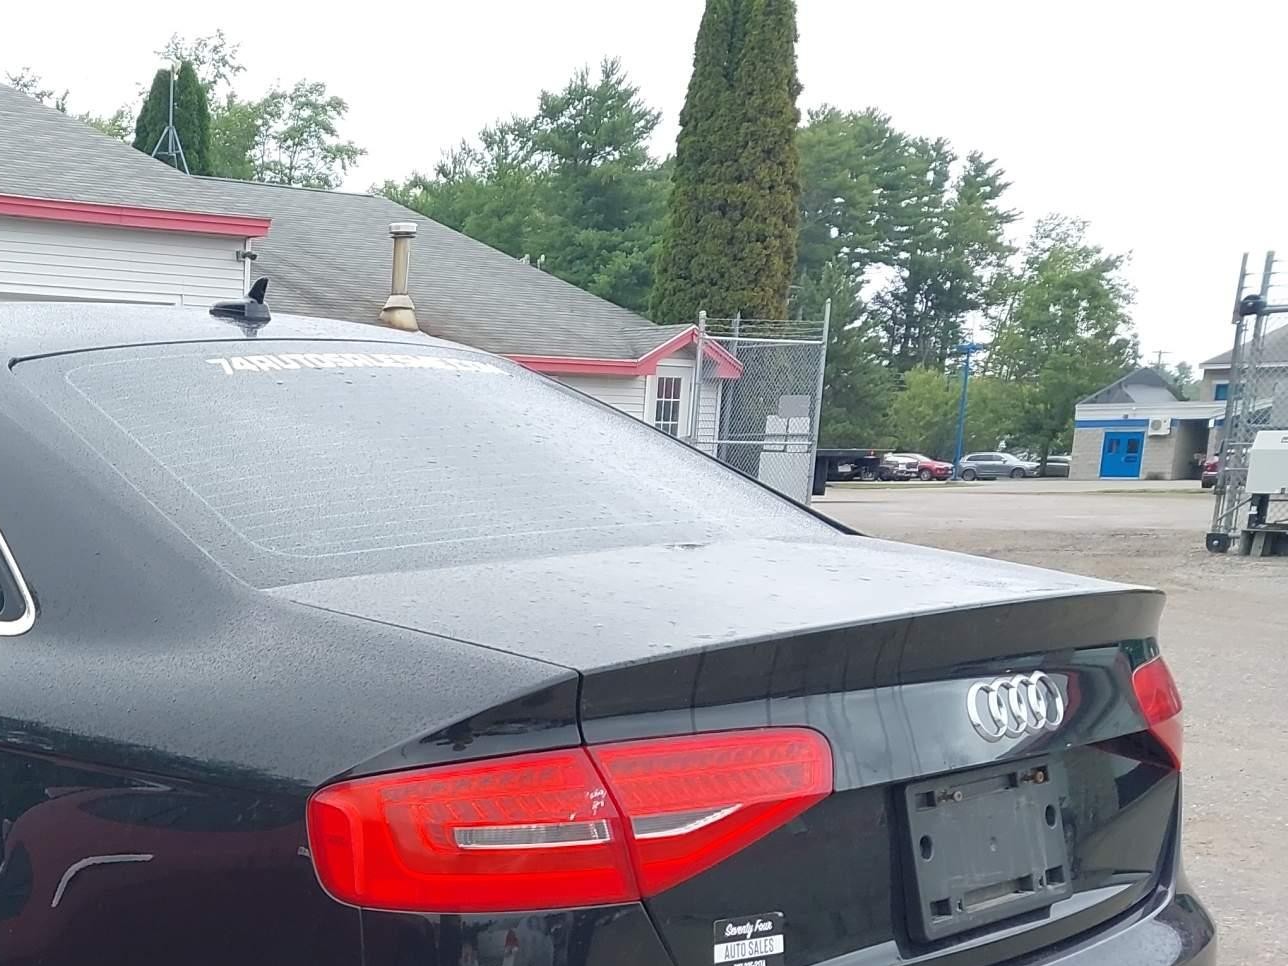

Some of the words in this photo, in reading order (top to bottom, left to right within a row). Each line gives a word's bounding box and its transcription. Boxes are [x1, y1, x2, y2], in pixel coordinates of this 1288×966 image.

[724, 922, 754, 939] Seventy
[754, 919, 773, 932] Four
[724, 942, 747, 961] AUTO
[748, 938, 774, 958] SALES
